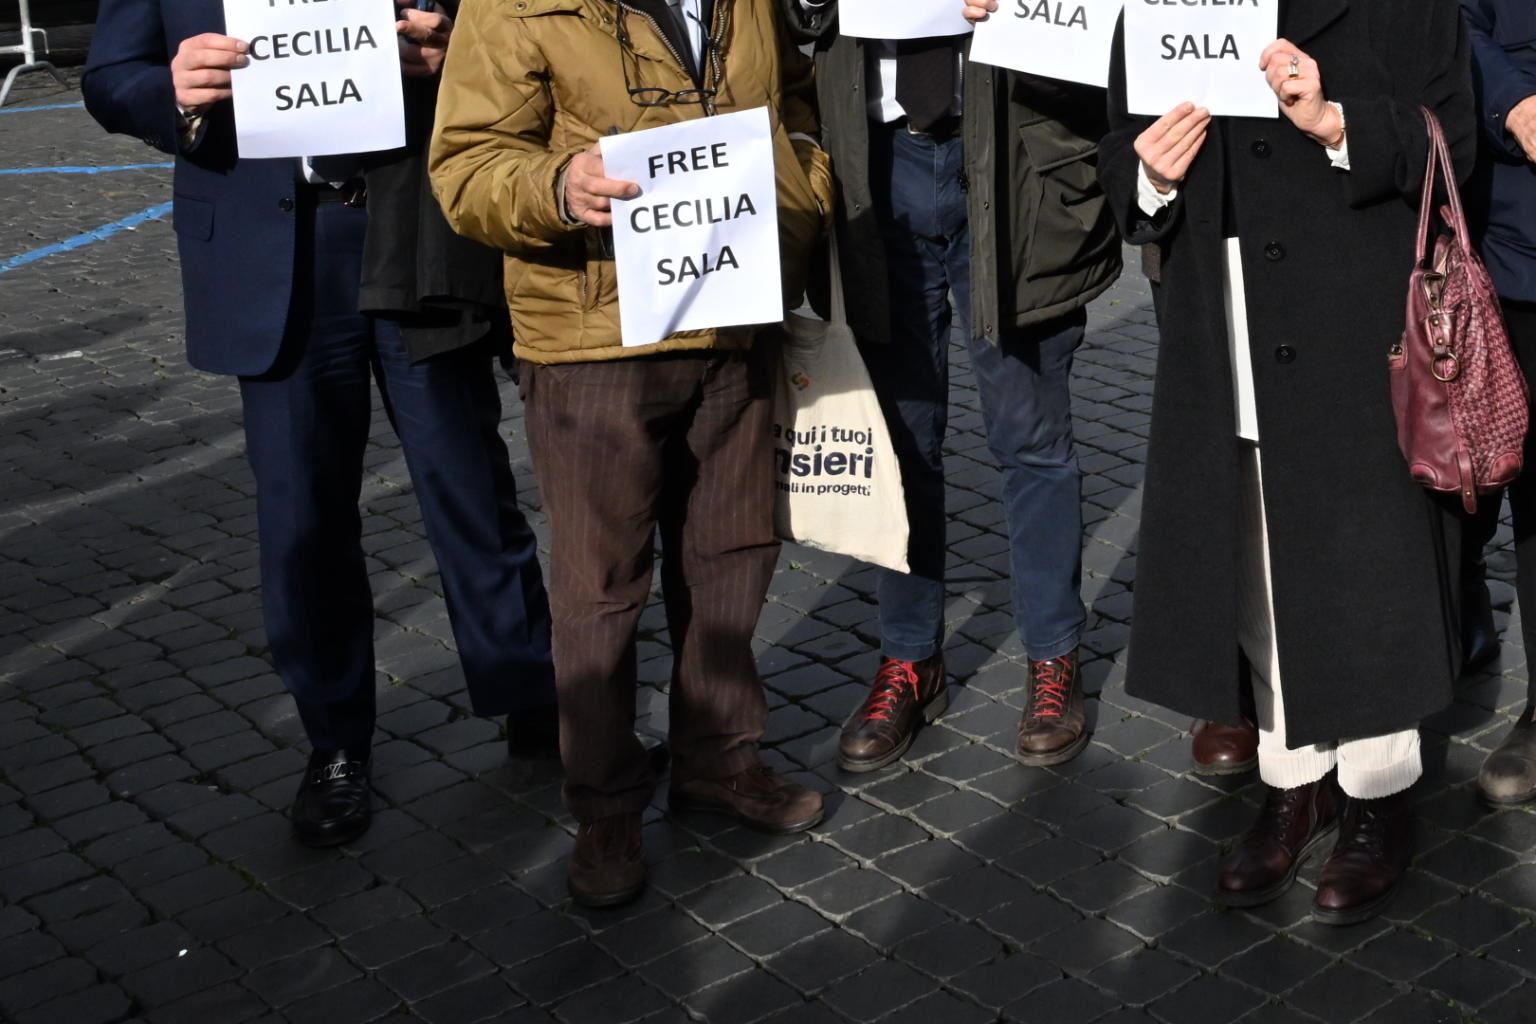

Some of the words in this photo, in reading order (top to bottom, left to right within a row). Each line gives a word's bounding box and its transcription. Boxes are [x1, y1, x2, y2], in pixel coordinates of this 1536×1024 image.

[249, 25, 377, 61] CECILIA
[1161, 33, 1240, 61] SALA
[275, 78, 363, 111] SALA
[647, 142, 729, 179] FREE
[630, 193, 757, 234] CECILIA
[657, 245, 739, 286] SALA
[785, 426, 816, 447] qui
[830, 426, 872, 446] tuoi
[802, 483, 815, 494] in
